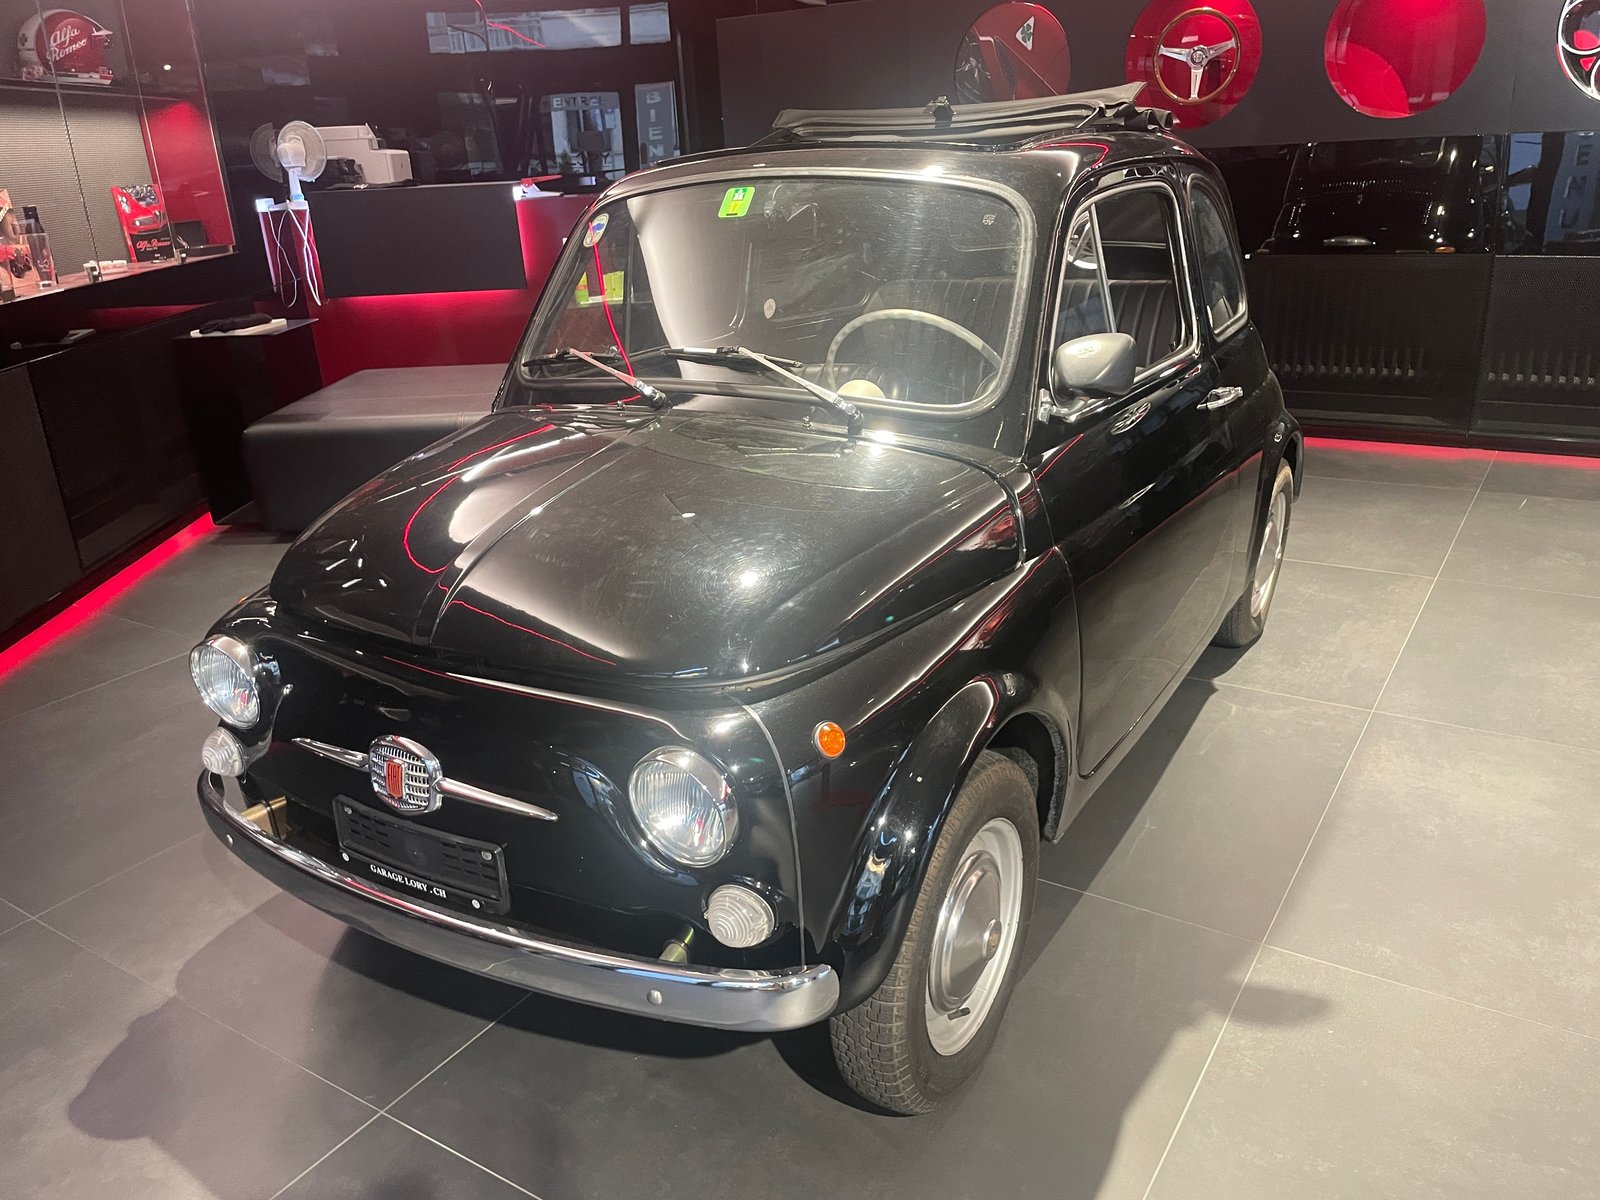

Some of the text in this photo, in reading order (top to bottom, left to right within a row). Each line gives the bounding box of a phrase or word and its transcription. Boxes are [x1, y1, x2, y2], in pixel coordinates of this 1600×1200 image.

[49, 25, 81, 47] Alfa
[46, 37, 88, 62] Romeo
[370, 864, 404, 884] GARAGE
[404, 877, 428, 892] LORY
